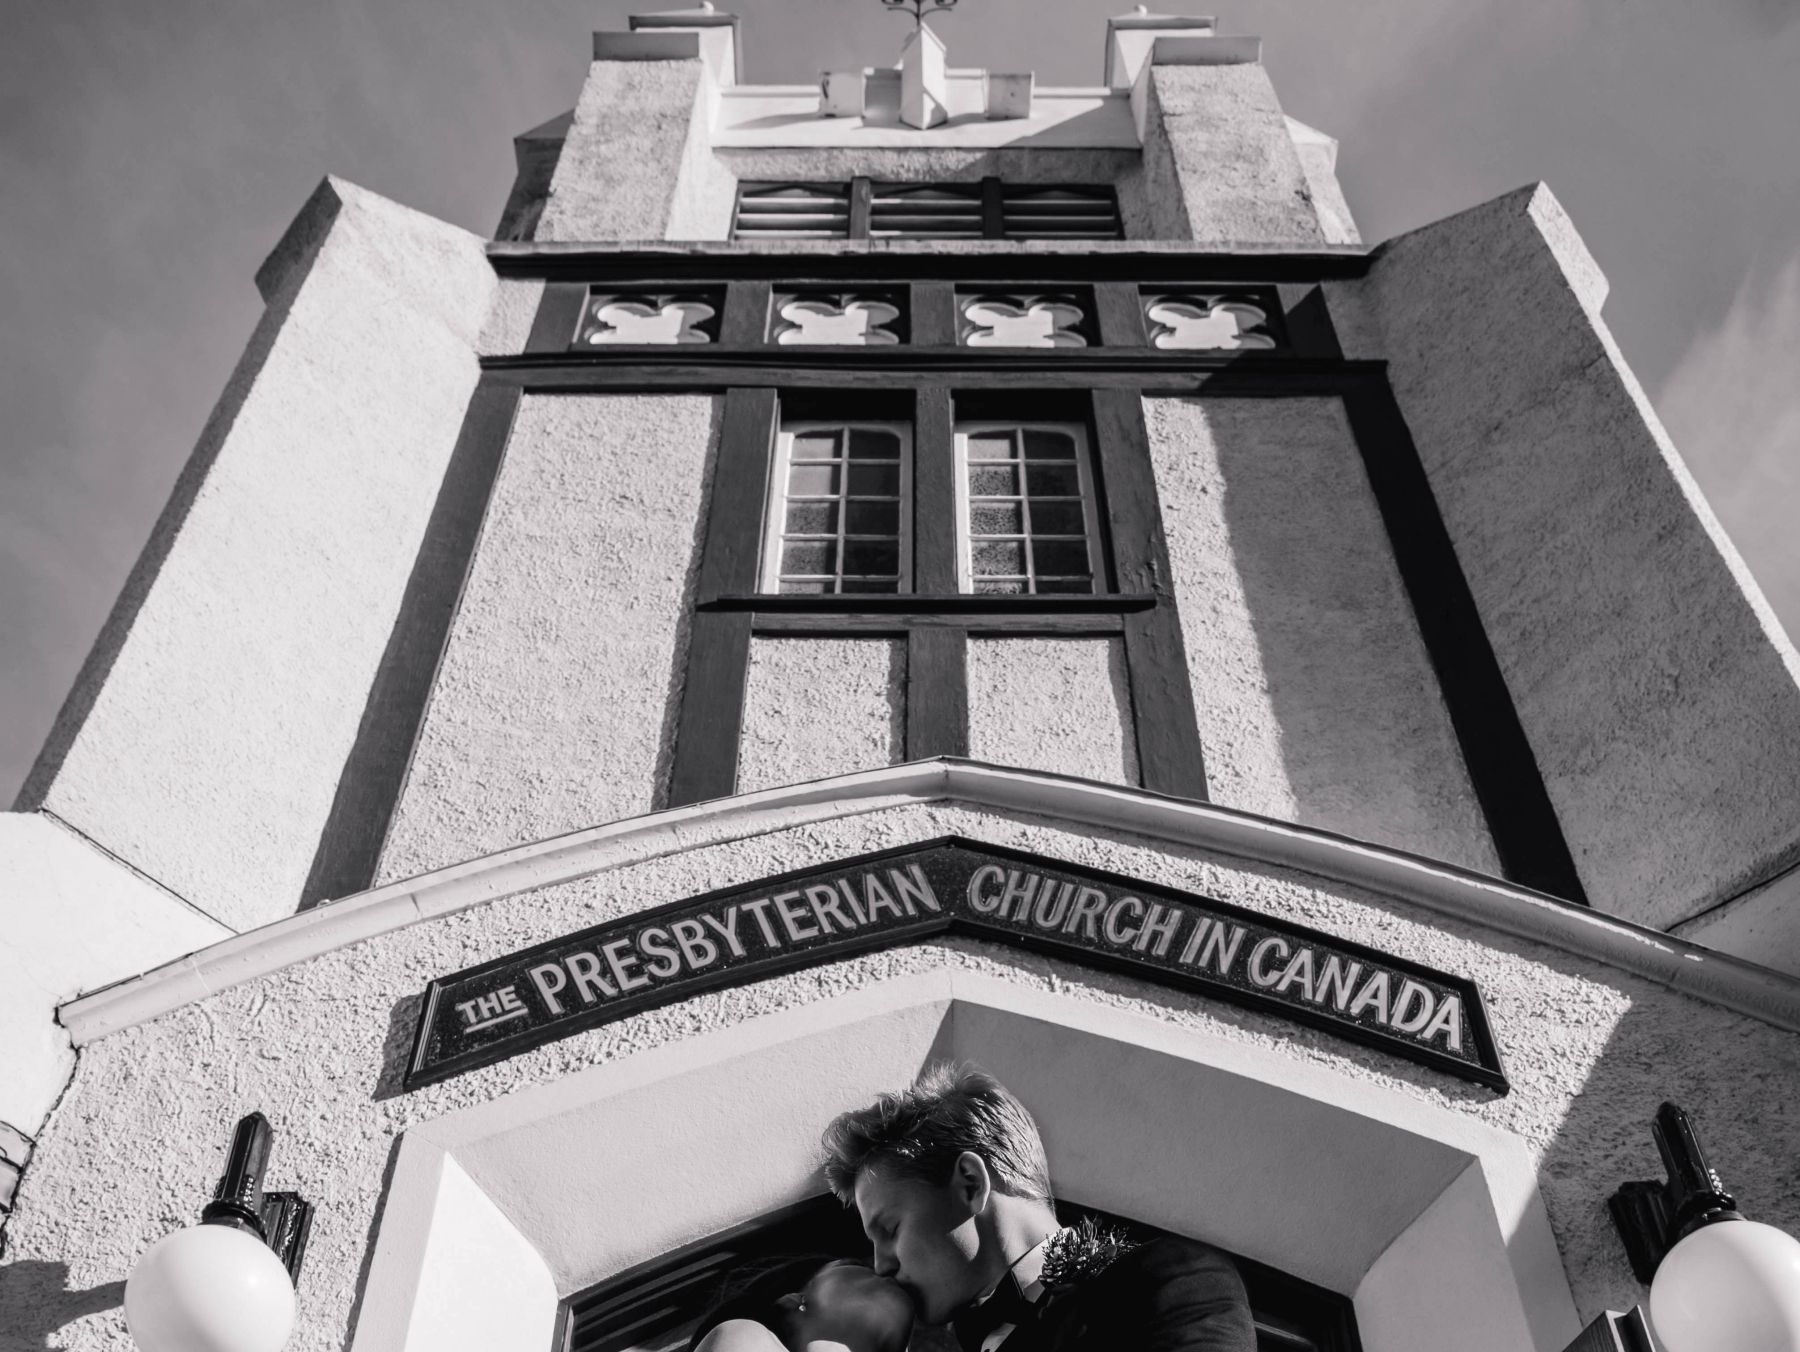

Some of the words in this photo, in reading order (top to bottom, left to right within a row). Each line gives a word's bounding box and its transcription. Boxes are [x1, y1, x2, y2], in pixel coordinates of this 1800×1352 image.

[458, 985, 522, 1027] THE
[527, 863, 941, 1014] PRESBYTERIAN
[967, 864, 1183, 957] CHURCH
[1180, 915, 1245, 976] IN
[1248, 935, 1464, 1051] CANADA
